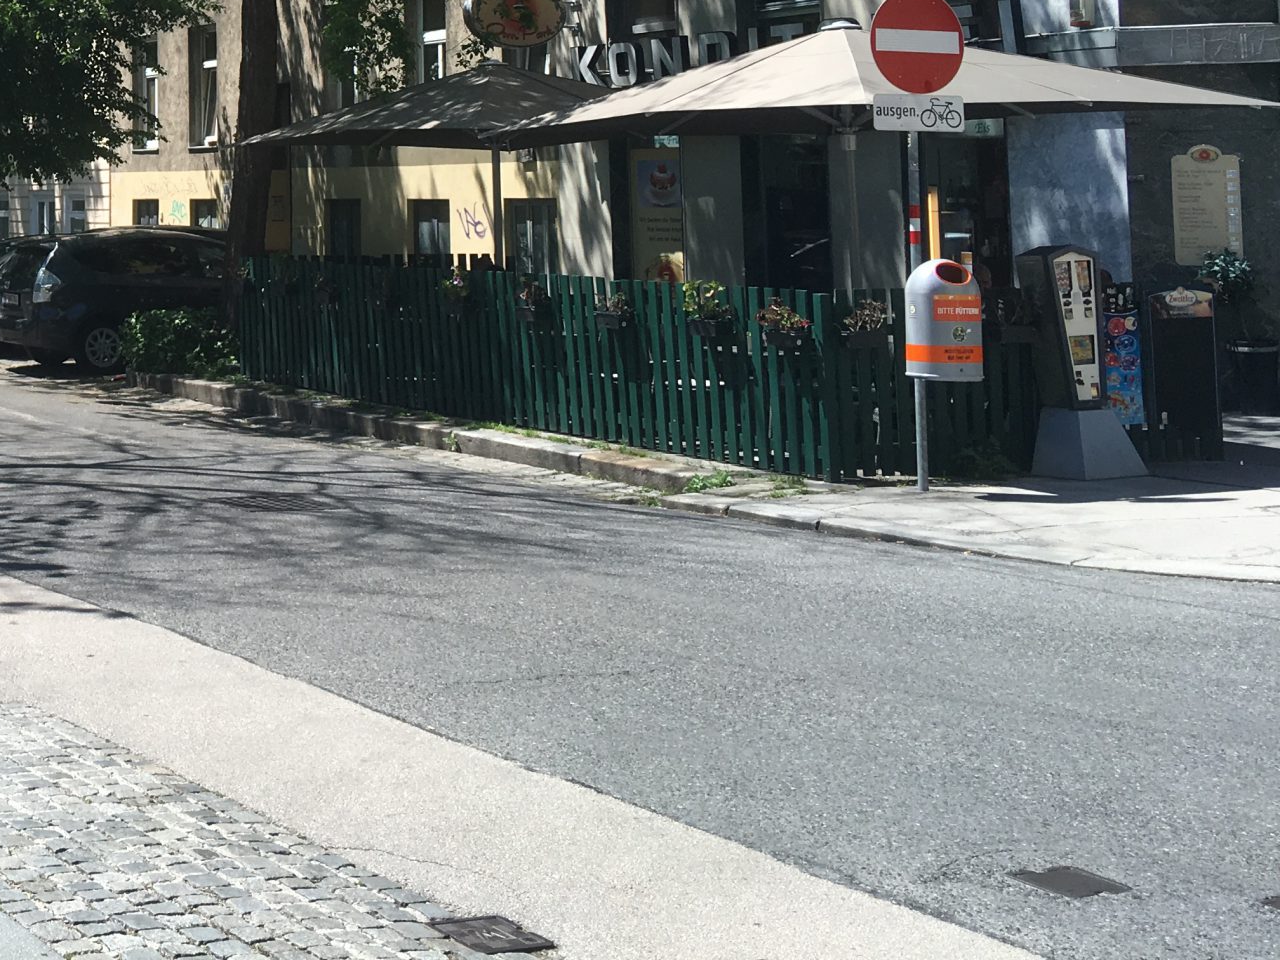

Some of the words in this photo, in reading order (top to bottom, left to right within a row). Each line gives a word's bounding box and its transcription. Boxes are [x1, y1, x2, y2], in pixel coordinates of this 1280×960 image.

[875, 105, 920, 120] ausgen.
[974, 120, 991, 134] Eis
[937, 307, 955, 315] BITTE
